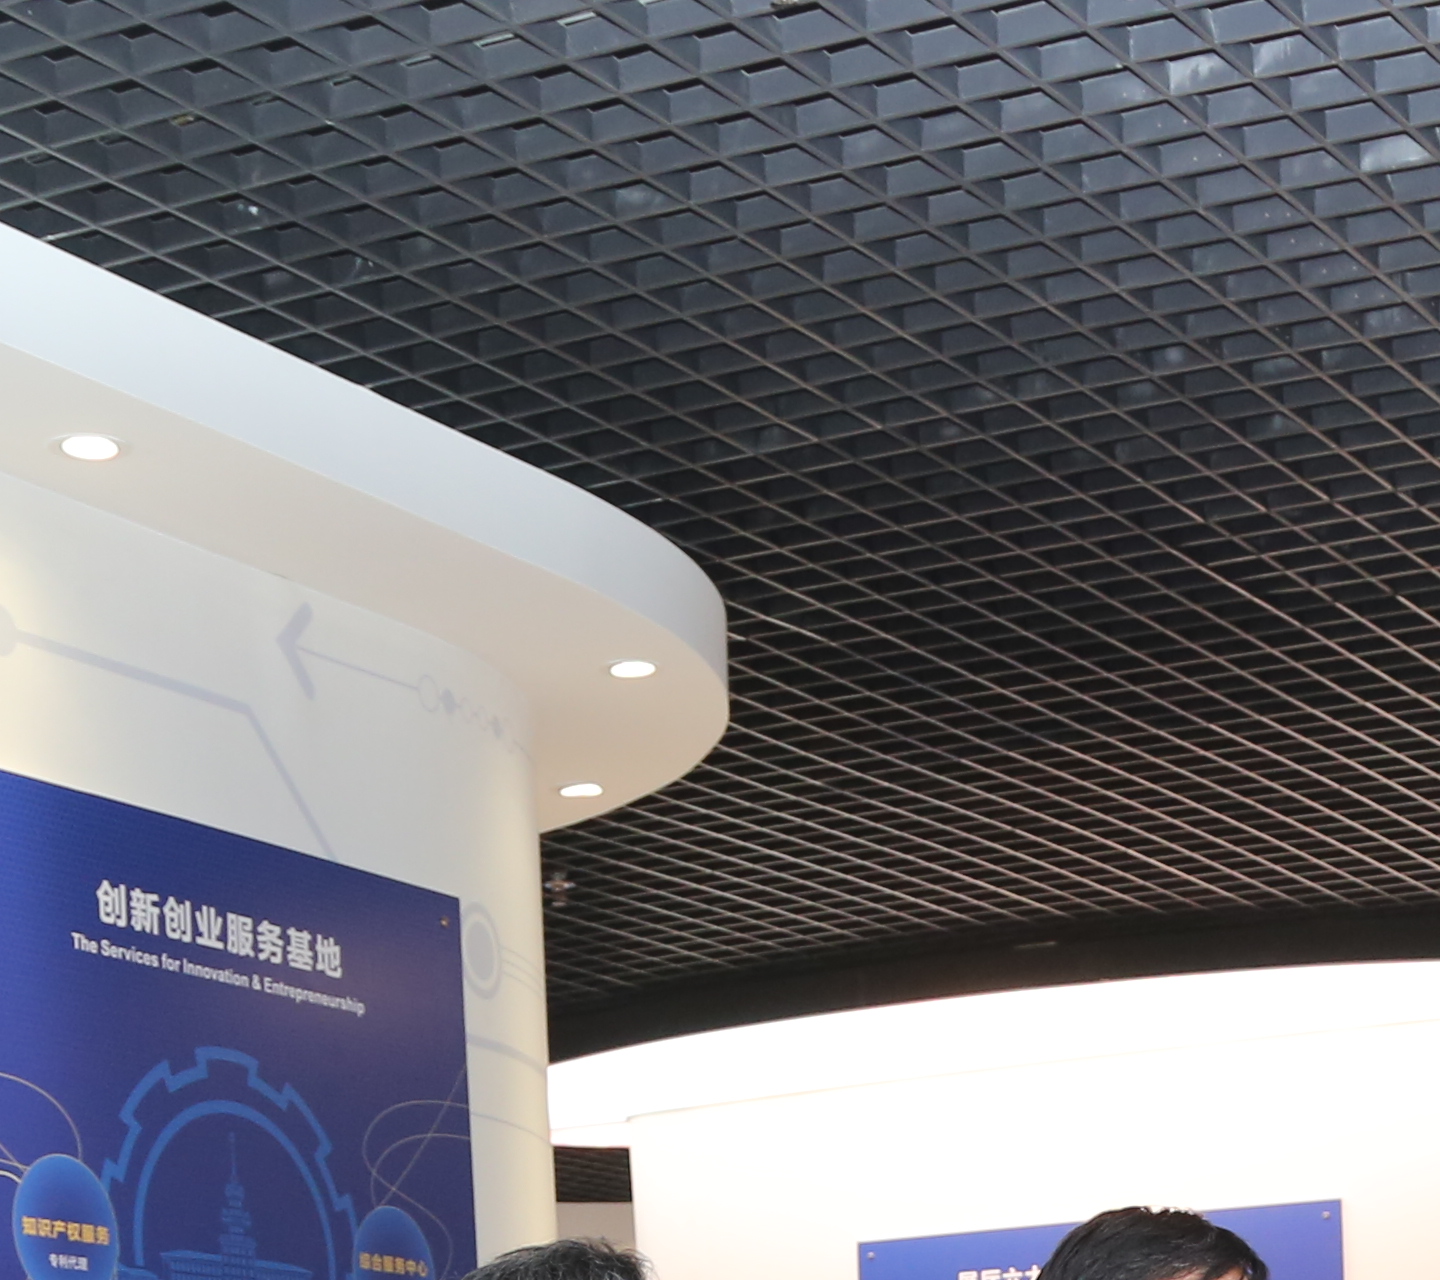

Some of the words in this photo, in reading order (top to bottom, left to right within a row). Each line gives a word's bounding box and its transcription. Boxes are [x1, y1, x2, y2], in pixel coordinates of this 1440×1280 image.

[96, 879, 343, 979] 创新创业服务基地
[71, 932, 98, 953] The
[101, 939, 160, 968] Services
[161, 953, 180, 972] for
[183, 958, 249, 988] Innovation
[252, 977, 261, 991] &
[264, 978, 366, 1017] Entrepreneurship
[22, 1216, 110, 1246] 知识产权服务
[49, 1253, 89, 1271] 专利代理
